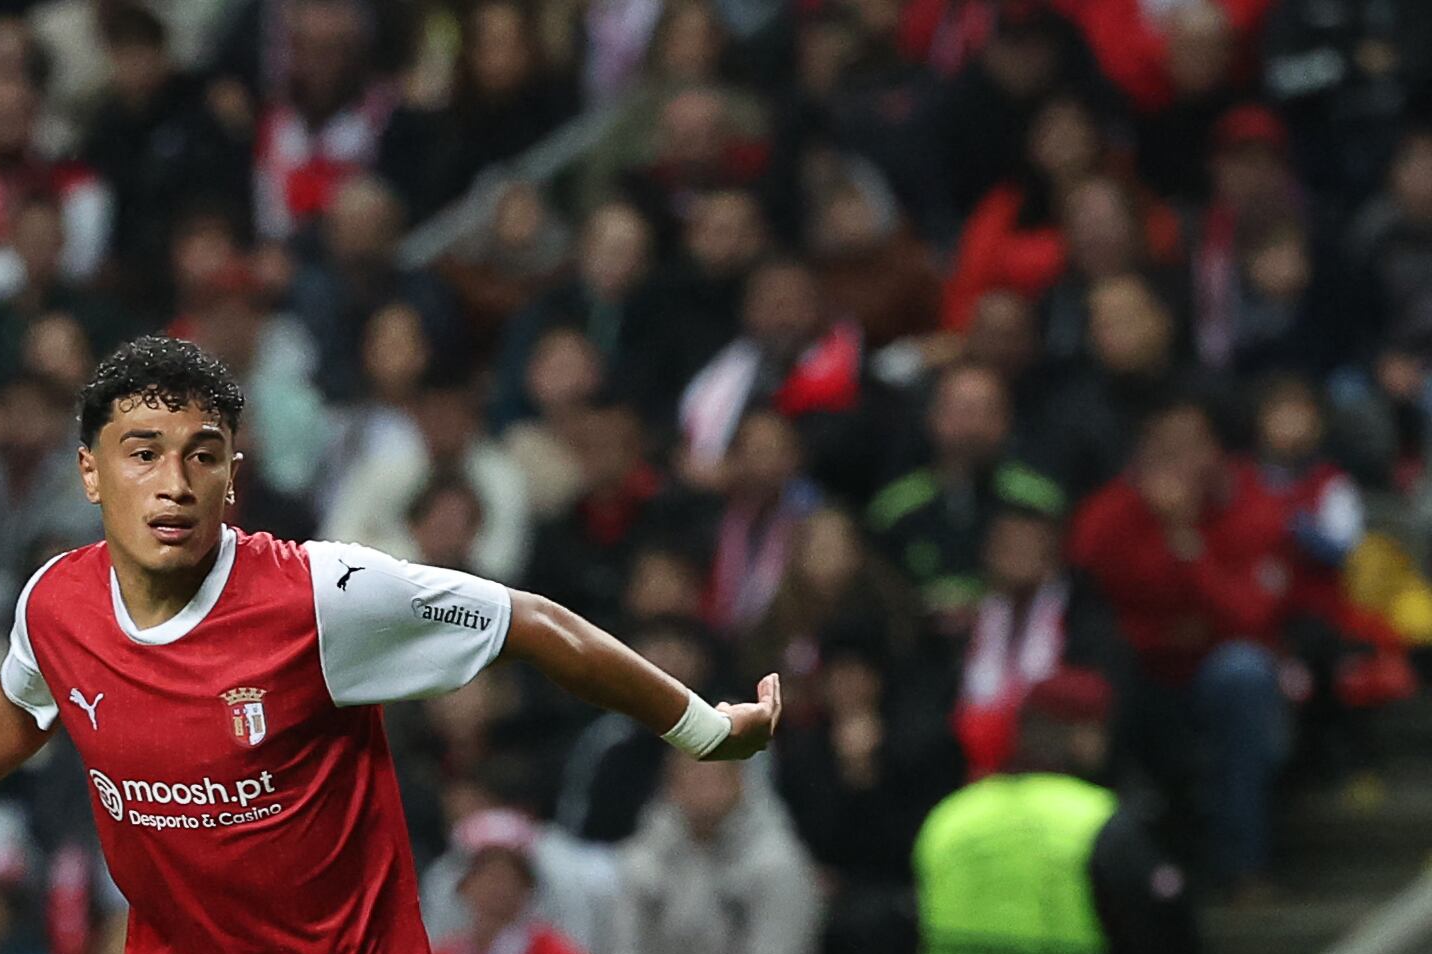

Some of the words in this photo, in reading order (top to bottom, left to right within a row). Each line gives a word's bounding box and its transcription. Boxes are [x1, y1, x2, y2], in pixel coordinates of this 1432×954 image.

[422, 604, 492, 631] auditiv
[122, 770, 275, 807] moosh.pt
[129, 810, 199, 831] Desporto
[202, 814, 216, 827] &
[219, 803, 282, 826] Casino
